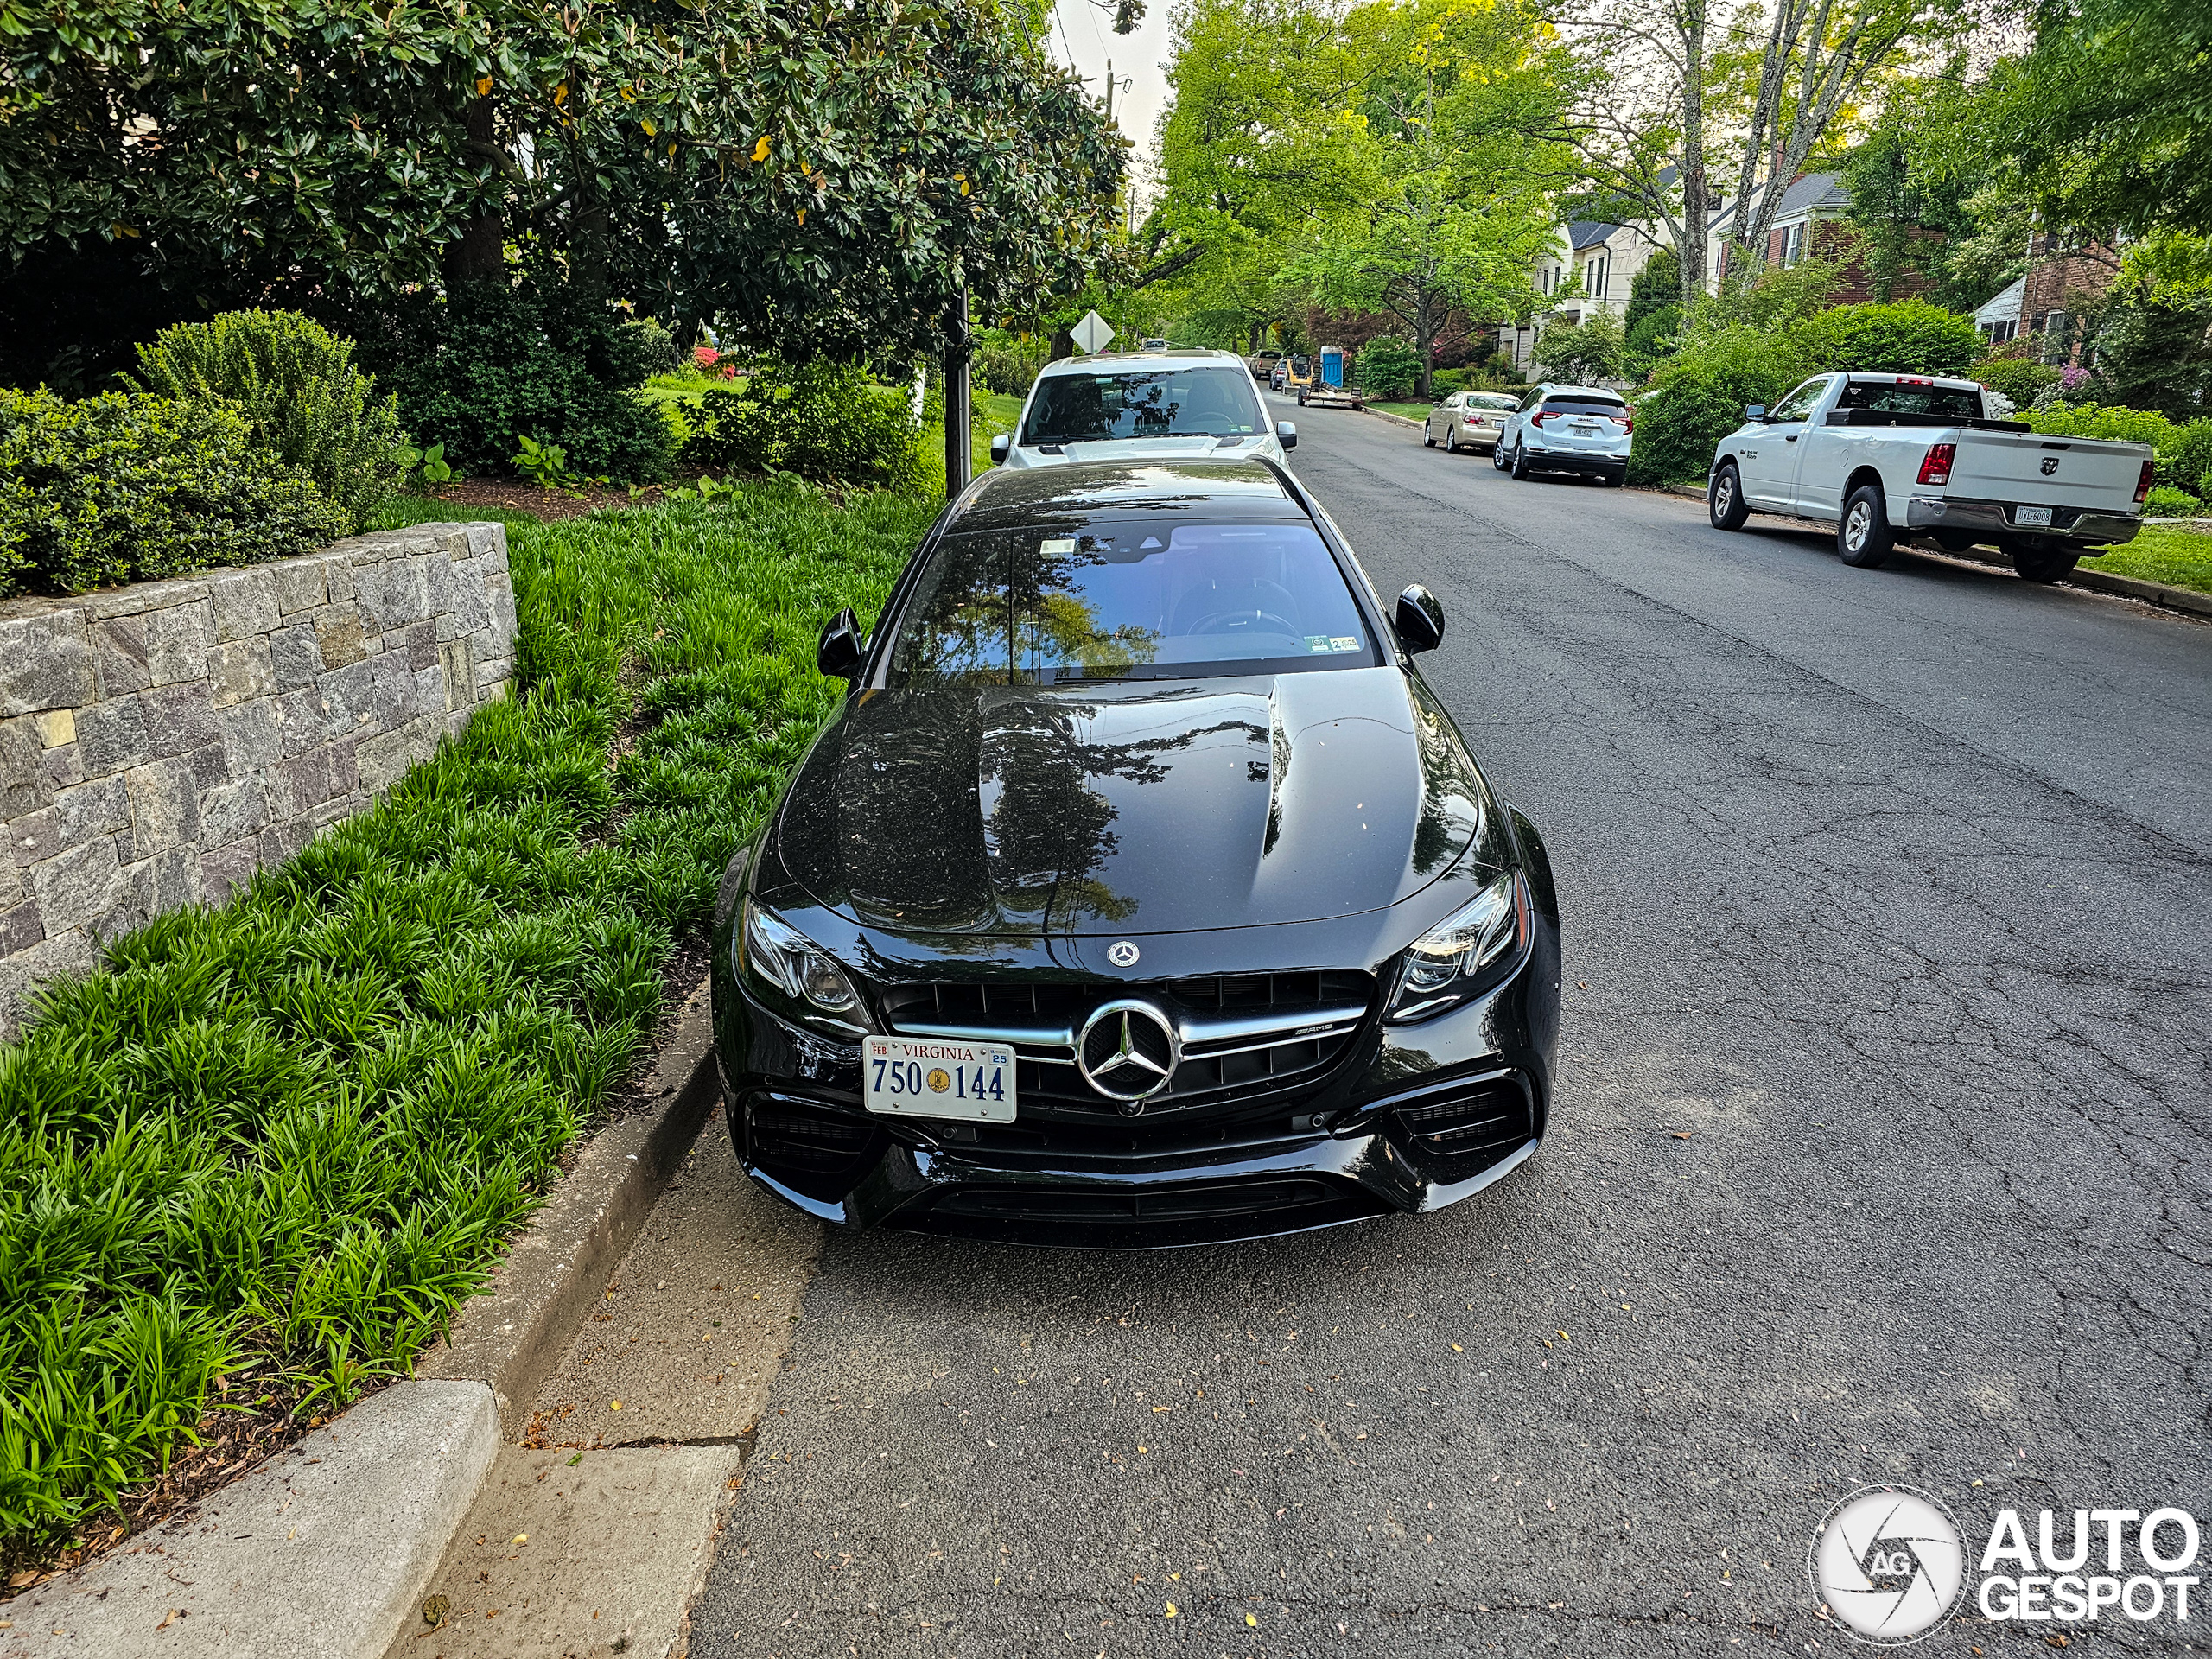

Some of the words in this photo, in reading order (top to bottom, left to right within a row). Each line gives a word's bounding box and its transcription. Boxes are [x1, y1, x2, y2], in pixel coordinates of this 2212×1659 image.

[1332, 640, 1341, 649] 2
[1307, 1023, 1333, 1033] AMG
[902, 1044, 975, 1061] VIRGINIA
[872, 1058, 923, 1096] 750
[956, 1064, 1005, 1102] 144
